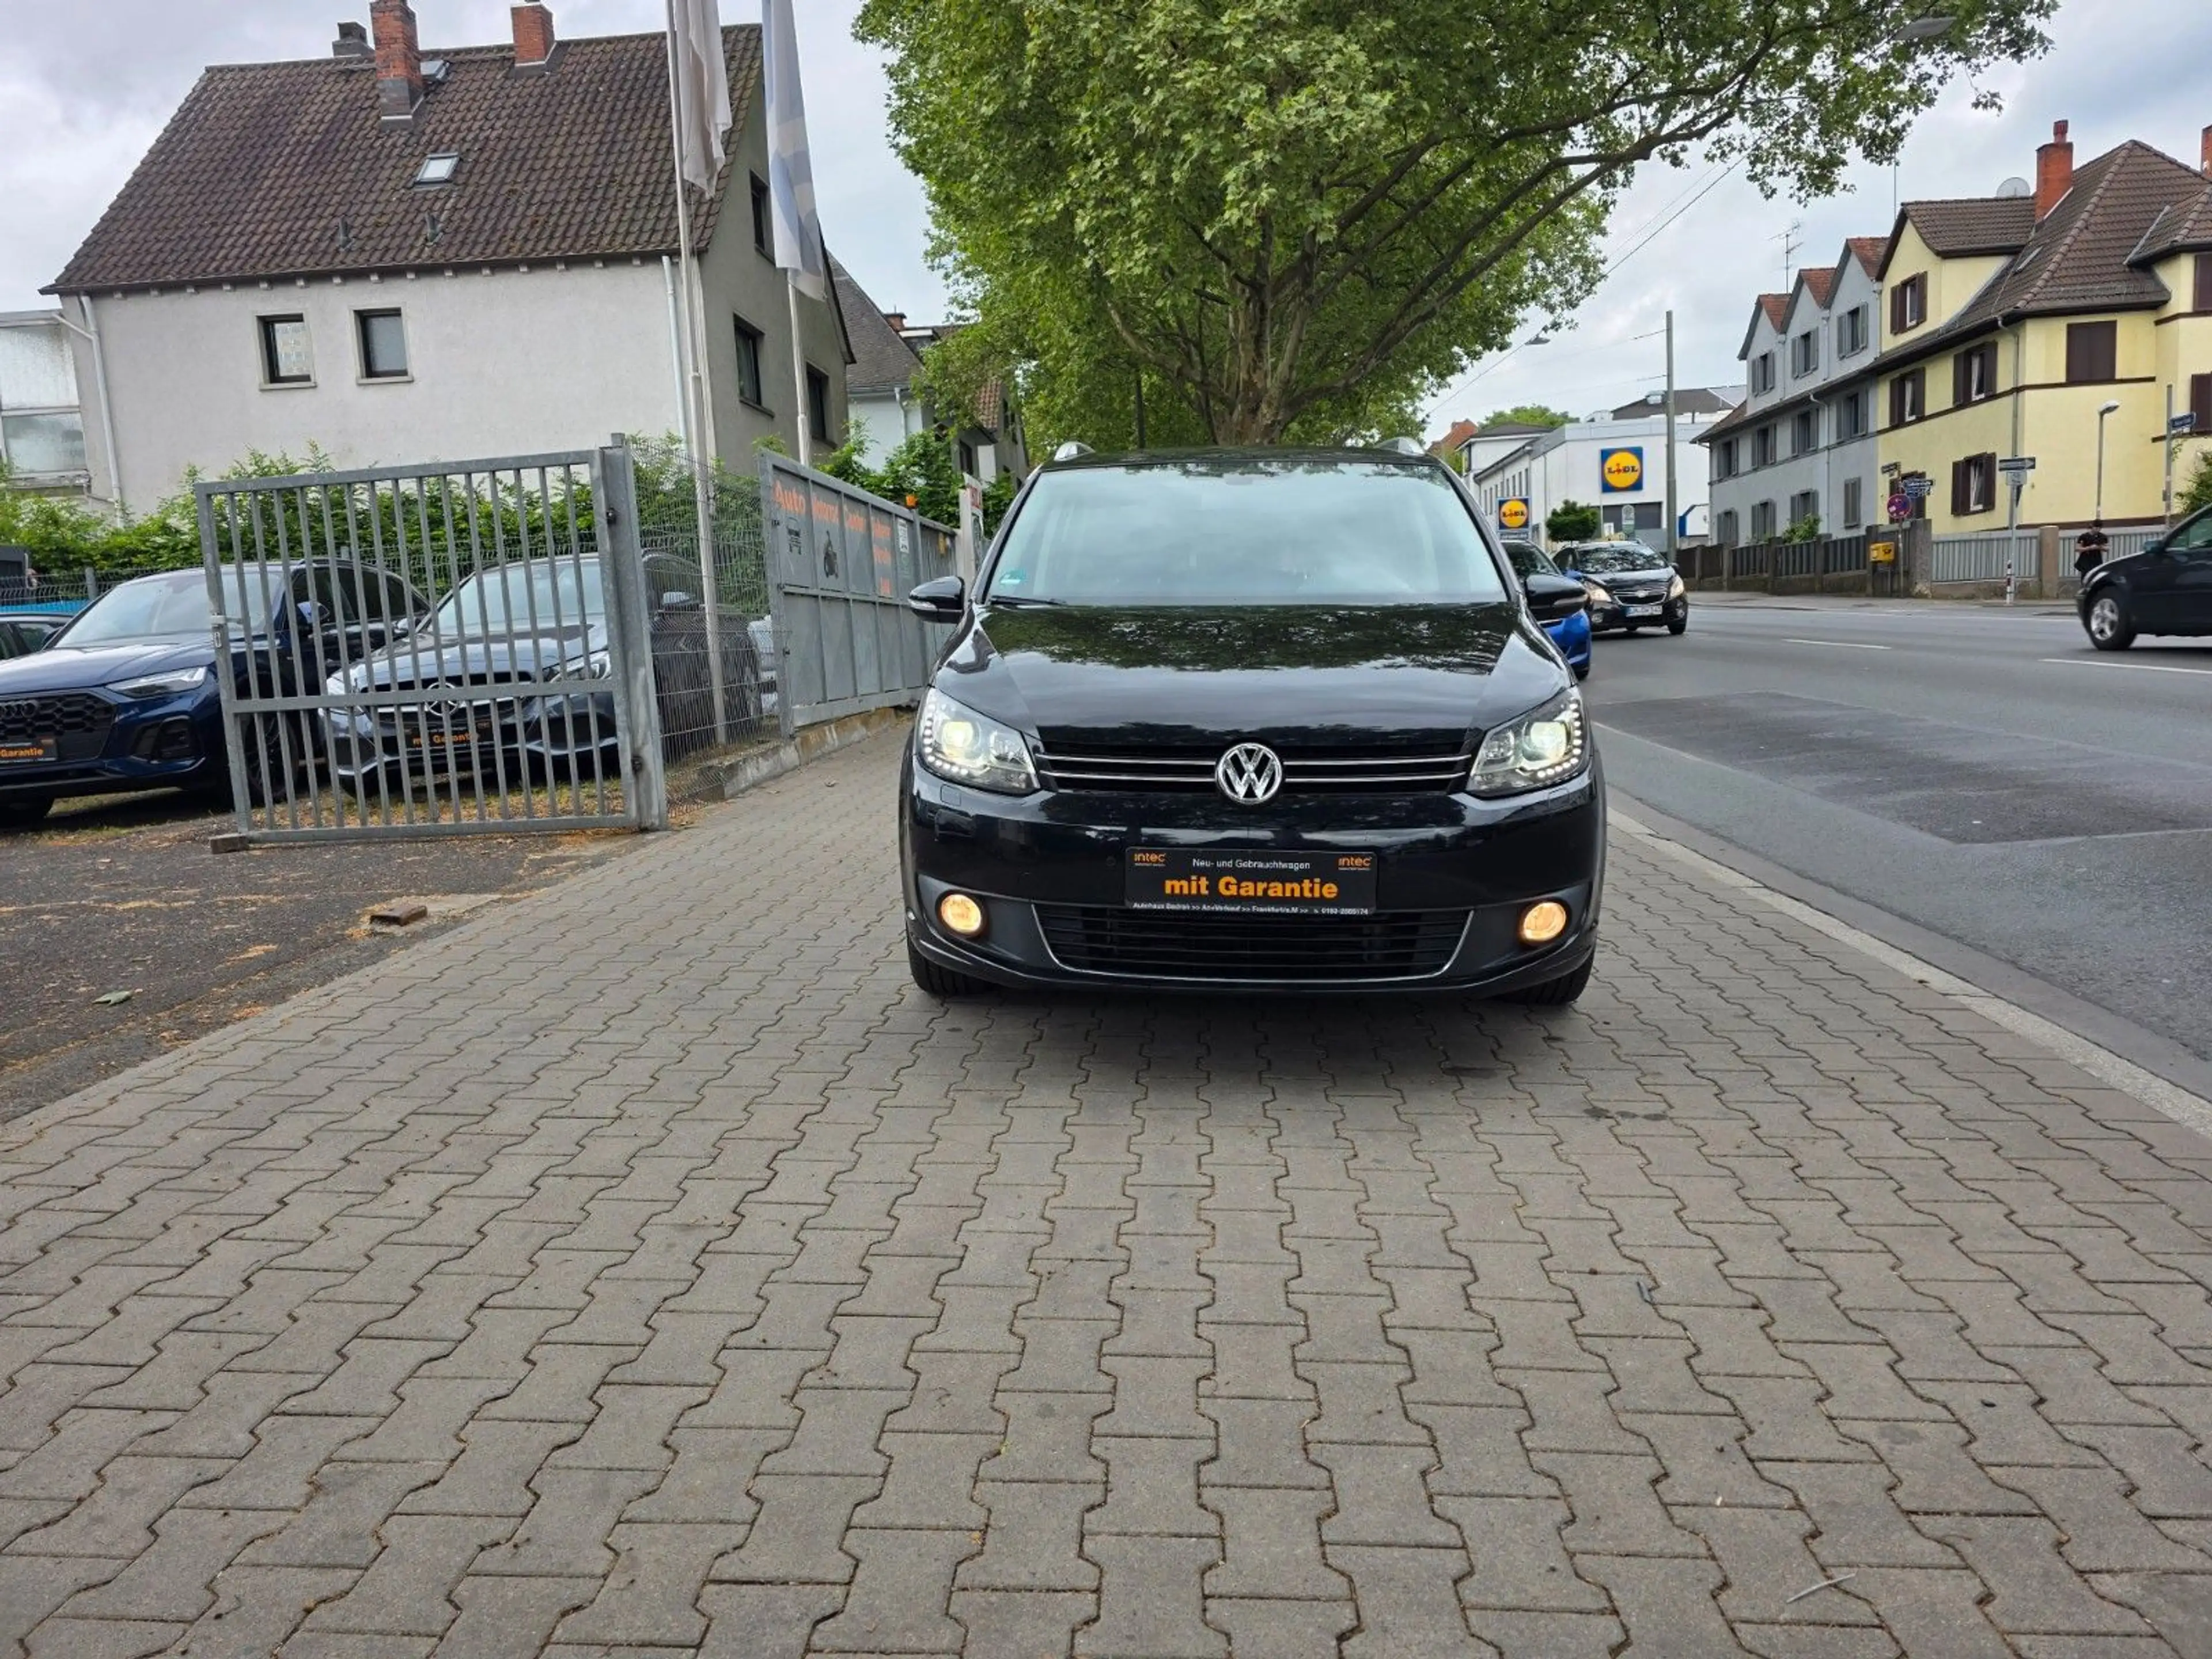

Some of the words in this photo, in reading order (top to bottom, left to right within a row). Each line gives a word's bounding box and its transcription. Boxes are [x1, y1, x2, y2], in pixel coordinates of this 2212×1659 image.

[1134, 853, 1166, 862] intec
[1338, 856, 1373, 867] intec
[1192, 858, 1215, 868] Neu-
[1216, 859, 1233, 868] und
[1235, 859, 1310, 871] Gebrauchtwagen
[1164, 875, 1210, 896] mit
[1218, 876, 1339, 899] Garantie
